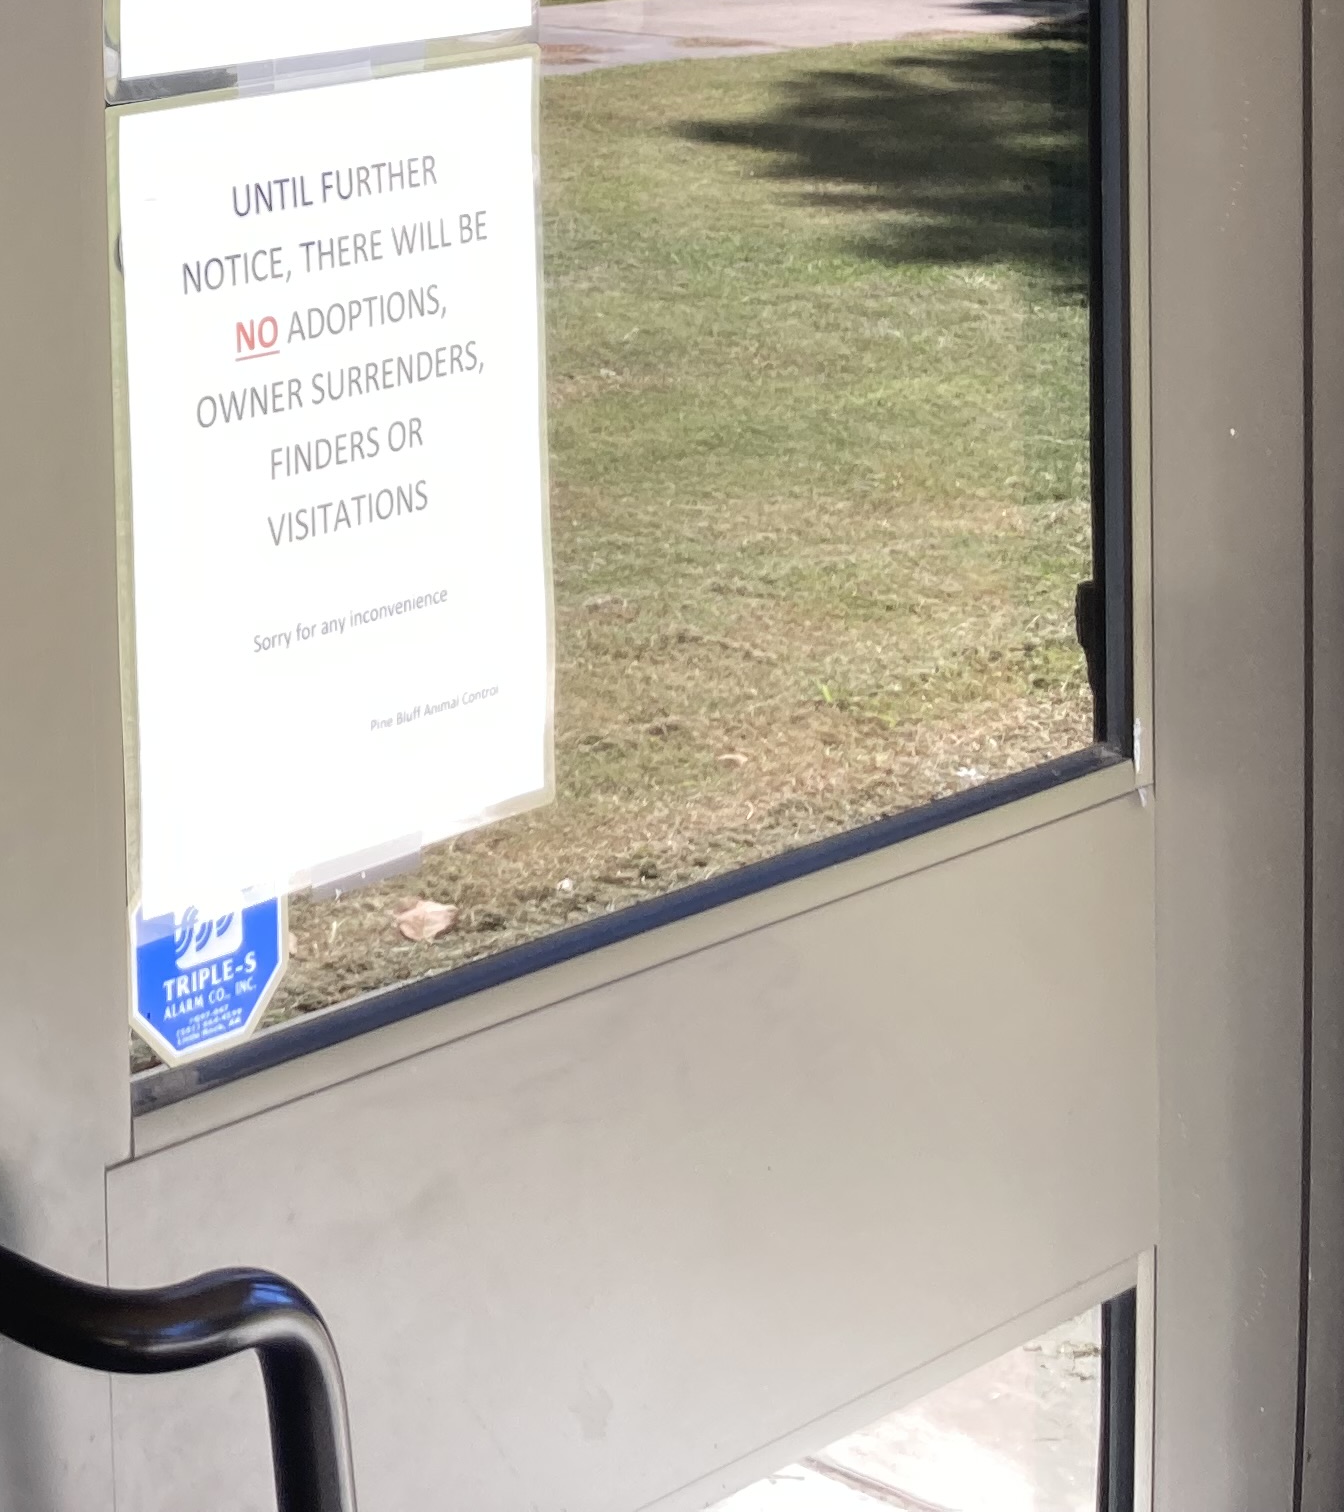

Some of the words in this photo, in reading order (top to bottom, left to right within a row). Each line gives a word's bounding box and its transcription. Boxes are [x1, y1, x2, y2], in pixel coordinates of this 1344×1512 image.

[232, 176, 313, 216] UNTIL
[321, 155, 437, 203] FURTHER
[182, 247, 291, 295] NOTICE,
[299, 230, 383, 272] THERE
[391, 218, 451, 256] WILL
[459, 211, 488, 244] BE
[236, 316, 278, 353] NO
[287, 284, 447, 344] ADOPTIONS,
[196, 378, 303, 428] OWNER
[311, 340, 484, 405] SURRENDERS,
[271, 427, 380, 480] FINDERS
[388, 417, 423, 452] OR
[268, 480, 428, 546] VISITATIONS
[253, 630, 292, 653] Sorry
[296, 623, 317, 641] for
[321, 616, 346, 636] any
[350, 589, 448, 627] inconvenience
[370, 715, 393, 732] Pine
[396, 706, 422, 726] Bluff
[424, 695, 460, 716] Animal
[462, 684, 499, 706] Control
[163, 951, 257, 1001] TRIPLE-S
[164, 994, 204, 1021] ALARM
[235, 977, 257, 996] INC.
